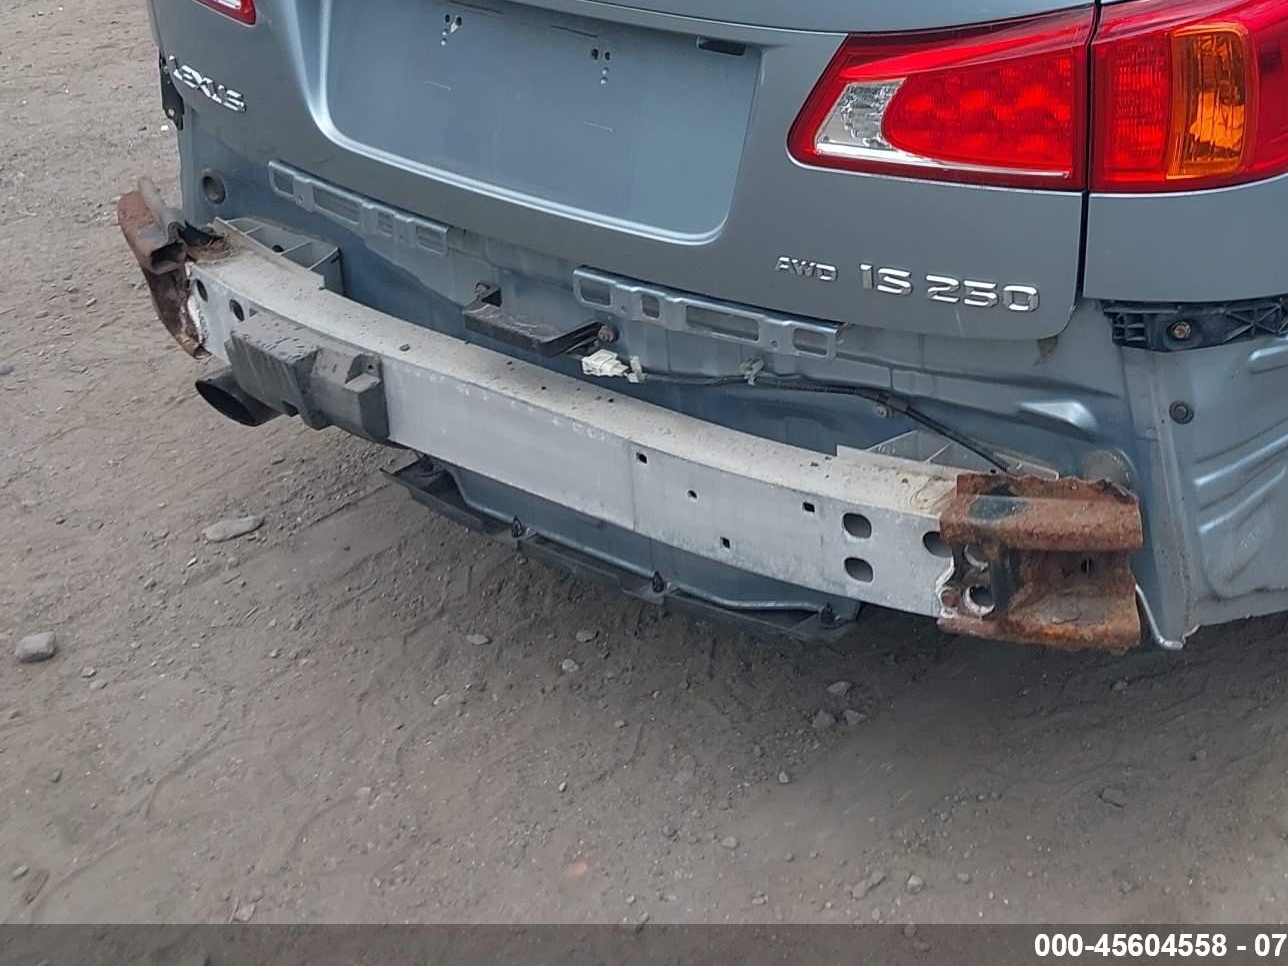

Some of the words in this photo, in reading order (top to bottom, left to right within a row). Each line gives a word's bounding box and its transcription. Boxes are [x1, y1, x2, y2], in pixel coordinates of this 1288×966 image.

[774, 256, 838, 282] AWD
[859, 263, 913, 297] IS
[926, 274, 1040, 312] 250
